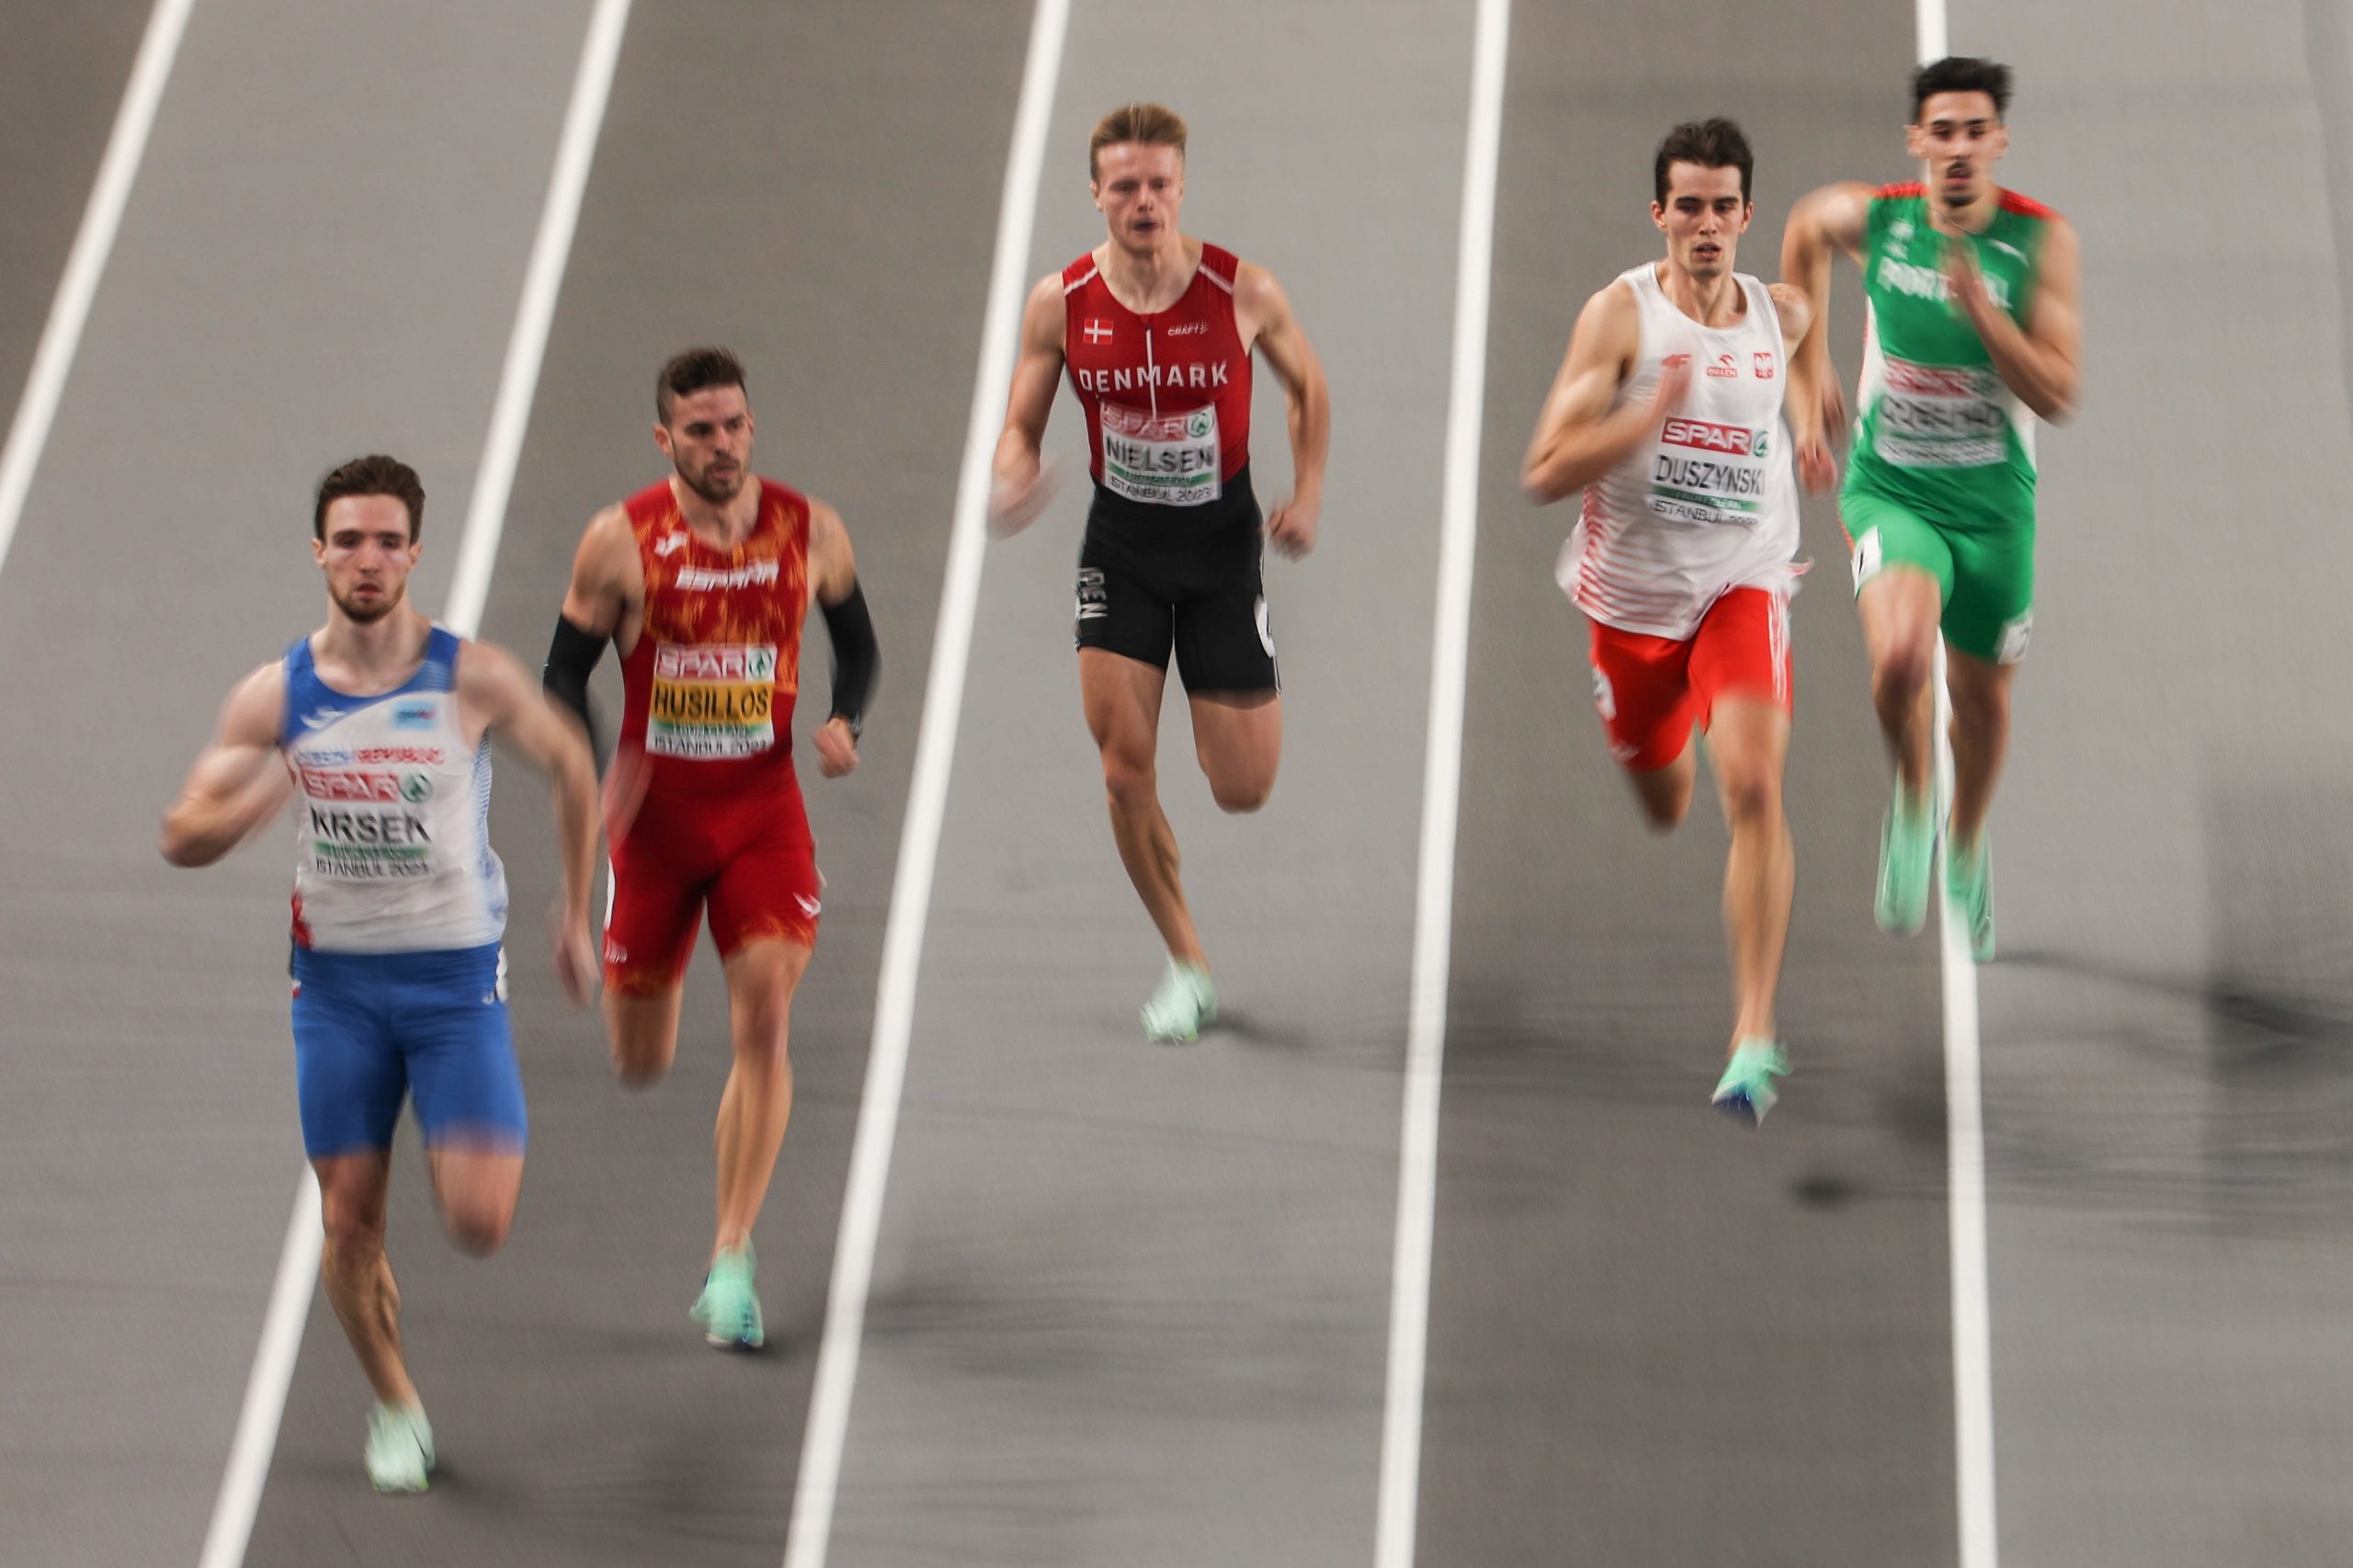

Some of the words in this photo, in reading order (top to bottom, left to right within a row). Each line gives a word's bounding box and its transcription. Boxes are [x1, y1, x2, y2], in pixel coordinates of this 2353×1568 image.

[1167, 323, 1198, 335] CRAFT
[1079, 360, 1228, 392] DENMARK
[1103, 406, 1186, 440] SPAR
[1665, 421, 1749, 453] SPAR
[1107, 436, 1215, 472] NIELSEN
[1111, 475, 1173, 502] ISTANBUL
[1654, 455, 1765, 495] DUSZYNSKI
[657, 649, 745, 678] SPAR
[654, 684, 768, 718] HUSILLOS
[303, 768, 400, 801] SPAR
